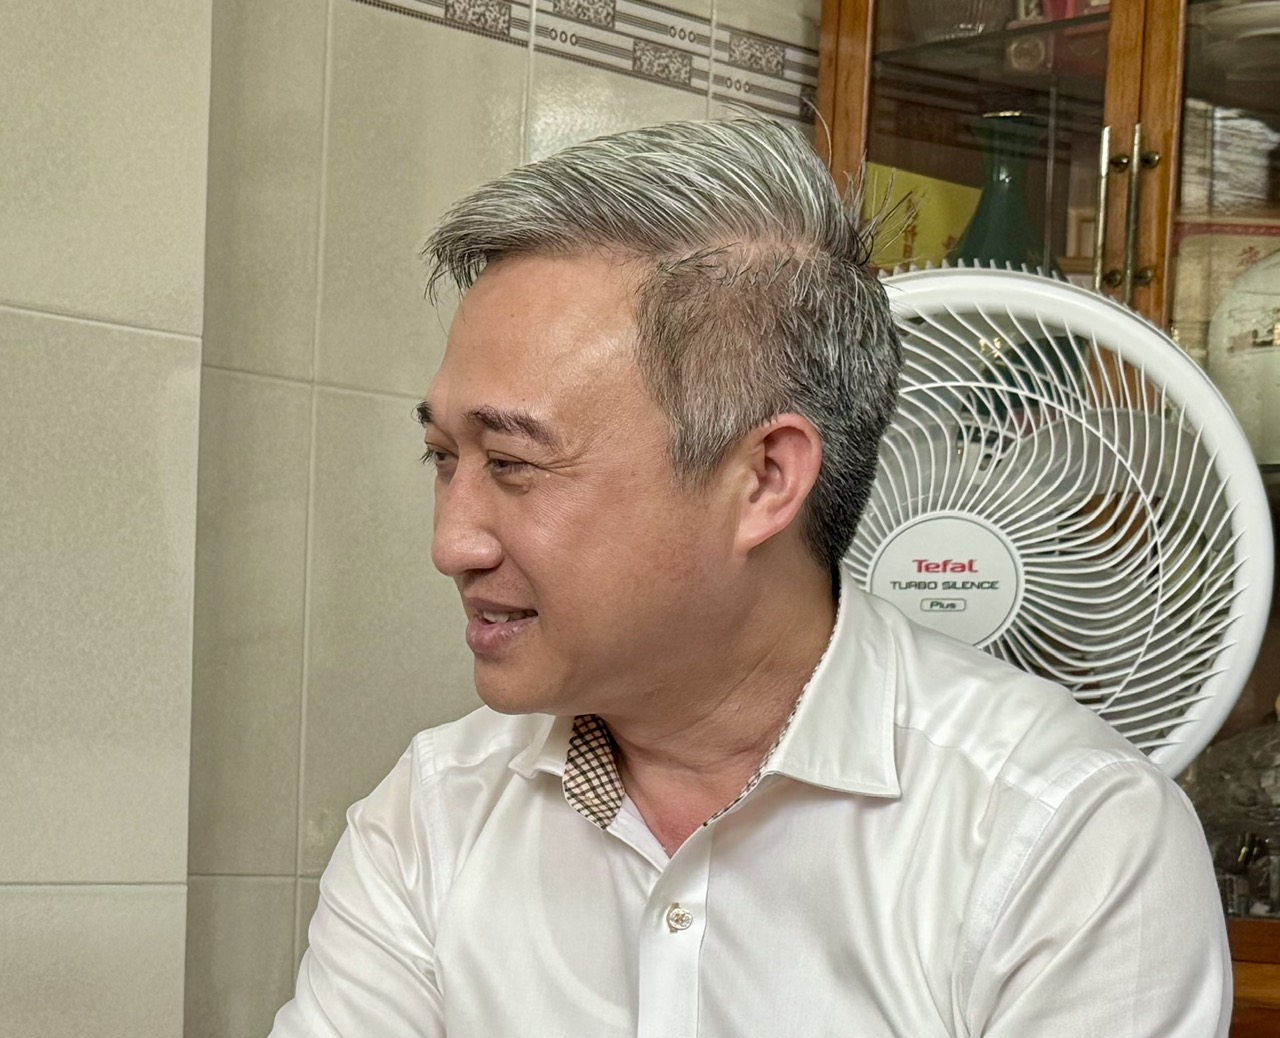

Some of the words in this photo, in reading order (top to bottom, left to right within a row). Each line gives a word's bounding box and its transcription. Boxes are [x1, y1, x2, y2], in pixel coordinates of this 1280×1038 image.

[912, 559, 978, 573] Tefal
[890, 581, 938, 590] TURBO
[942, 581, 999, 590] SILENCE
[930, 601, 956, 609] Plus
